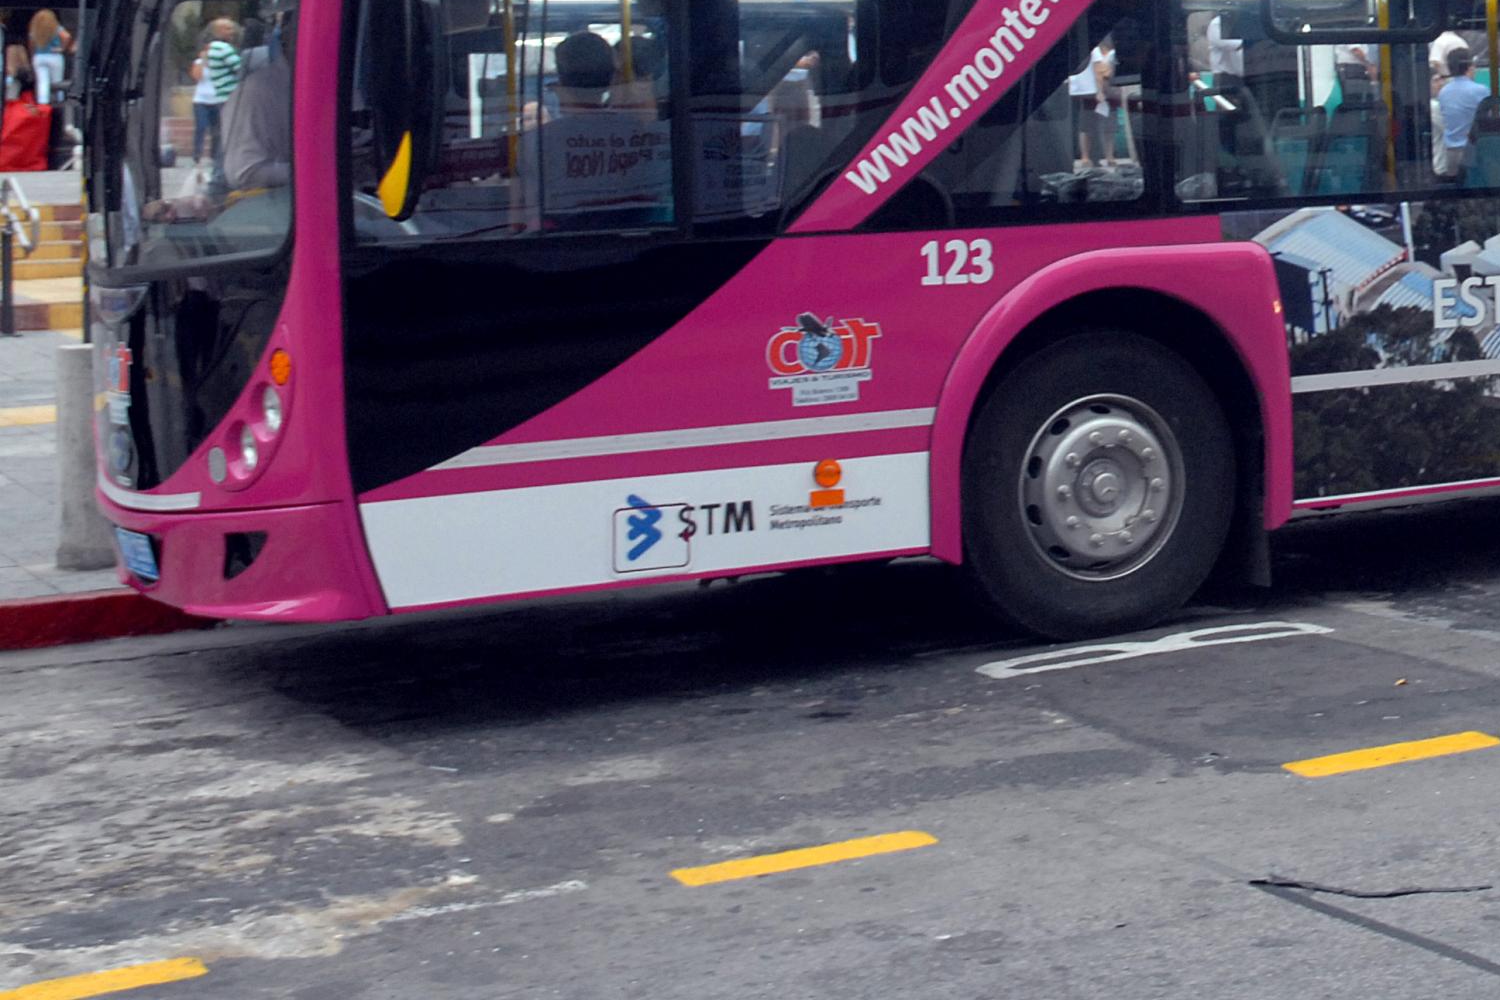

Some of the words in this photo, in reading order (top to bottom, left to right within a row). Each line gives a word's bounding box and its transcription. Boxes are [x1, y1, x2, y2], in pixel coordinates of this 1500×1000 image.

[921, 238, 994, 286] 123
[679, 500, 755, 538] STM
[769, 515, 842, 531] Metropolitano
